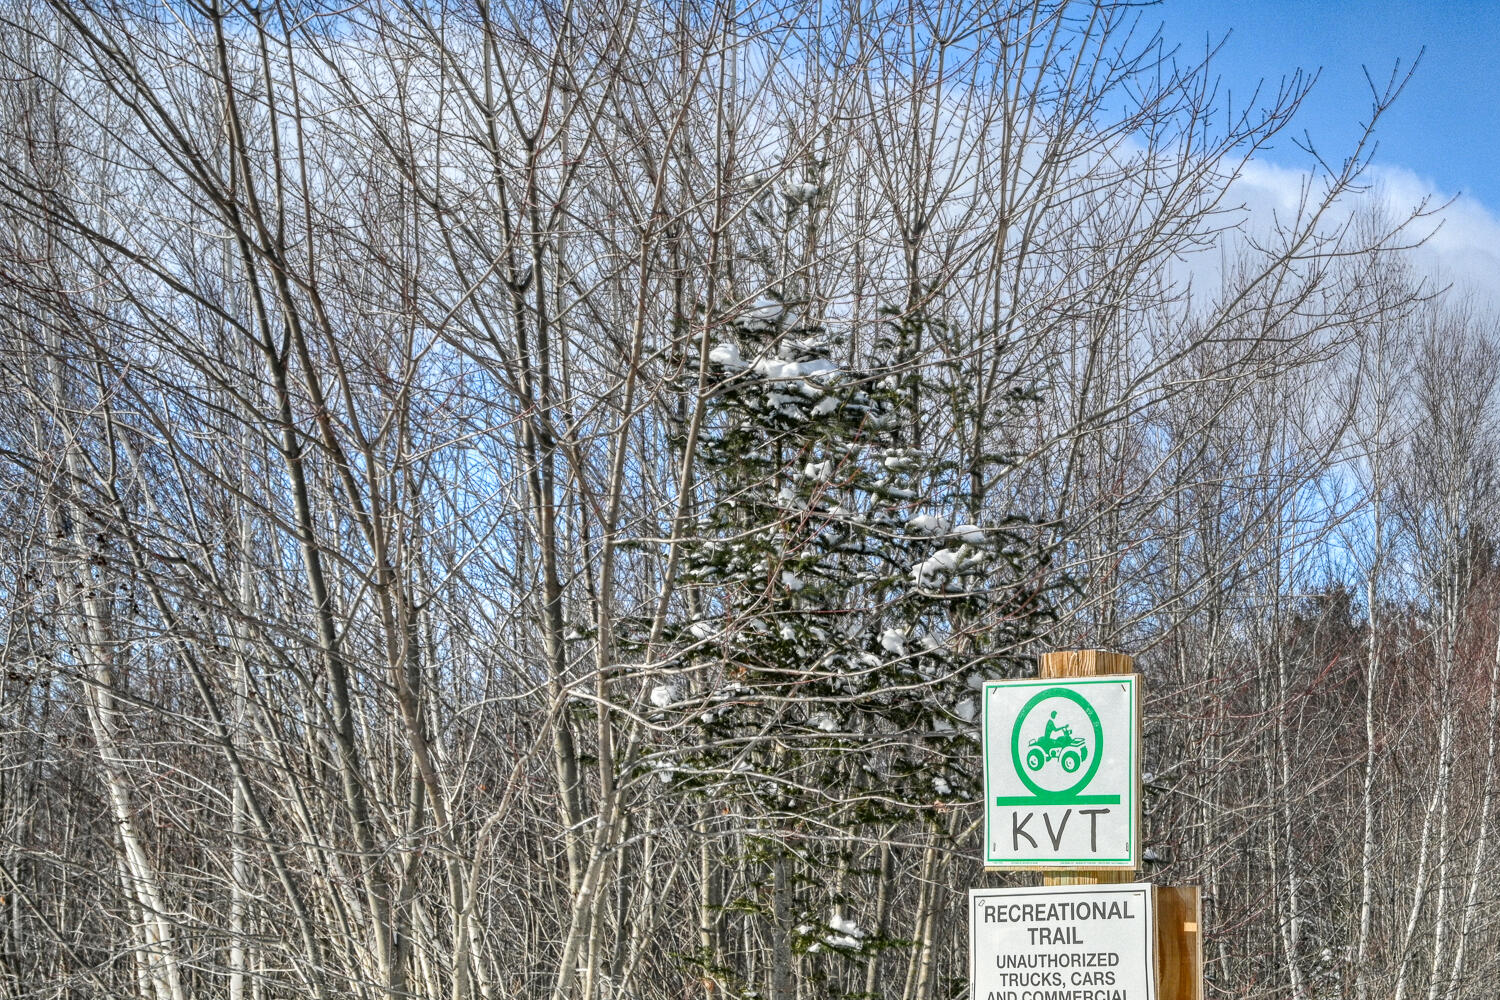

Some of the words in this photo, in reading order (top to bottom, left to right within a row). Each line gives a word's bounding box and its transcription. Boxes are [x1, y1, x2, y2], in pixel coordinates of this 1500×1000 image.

[1012, 808, 1111, 852] KVT
[984, 901, 1135, 923] RECREATIONAL
[1027, 927, 1084, 945] TRAIL
[996, 952, 1119, 969] UNAUTHORIZED
[1000, 972, 1066, 988] TRUCKS,
[1071, 971, 1116, 986] CARS
